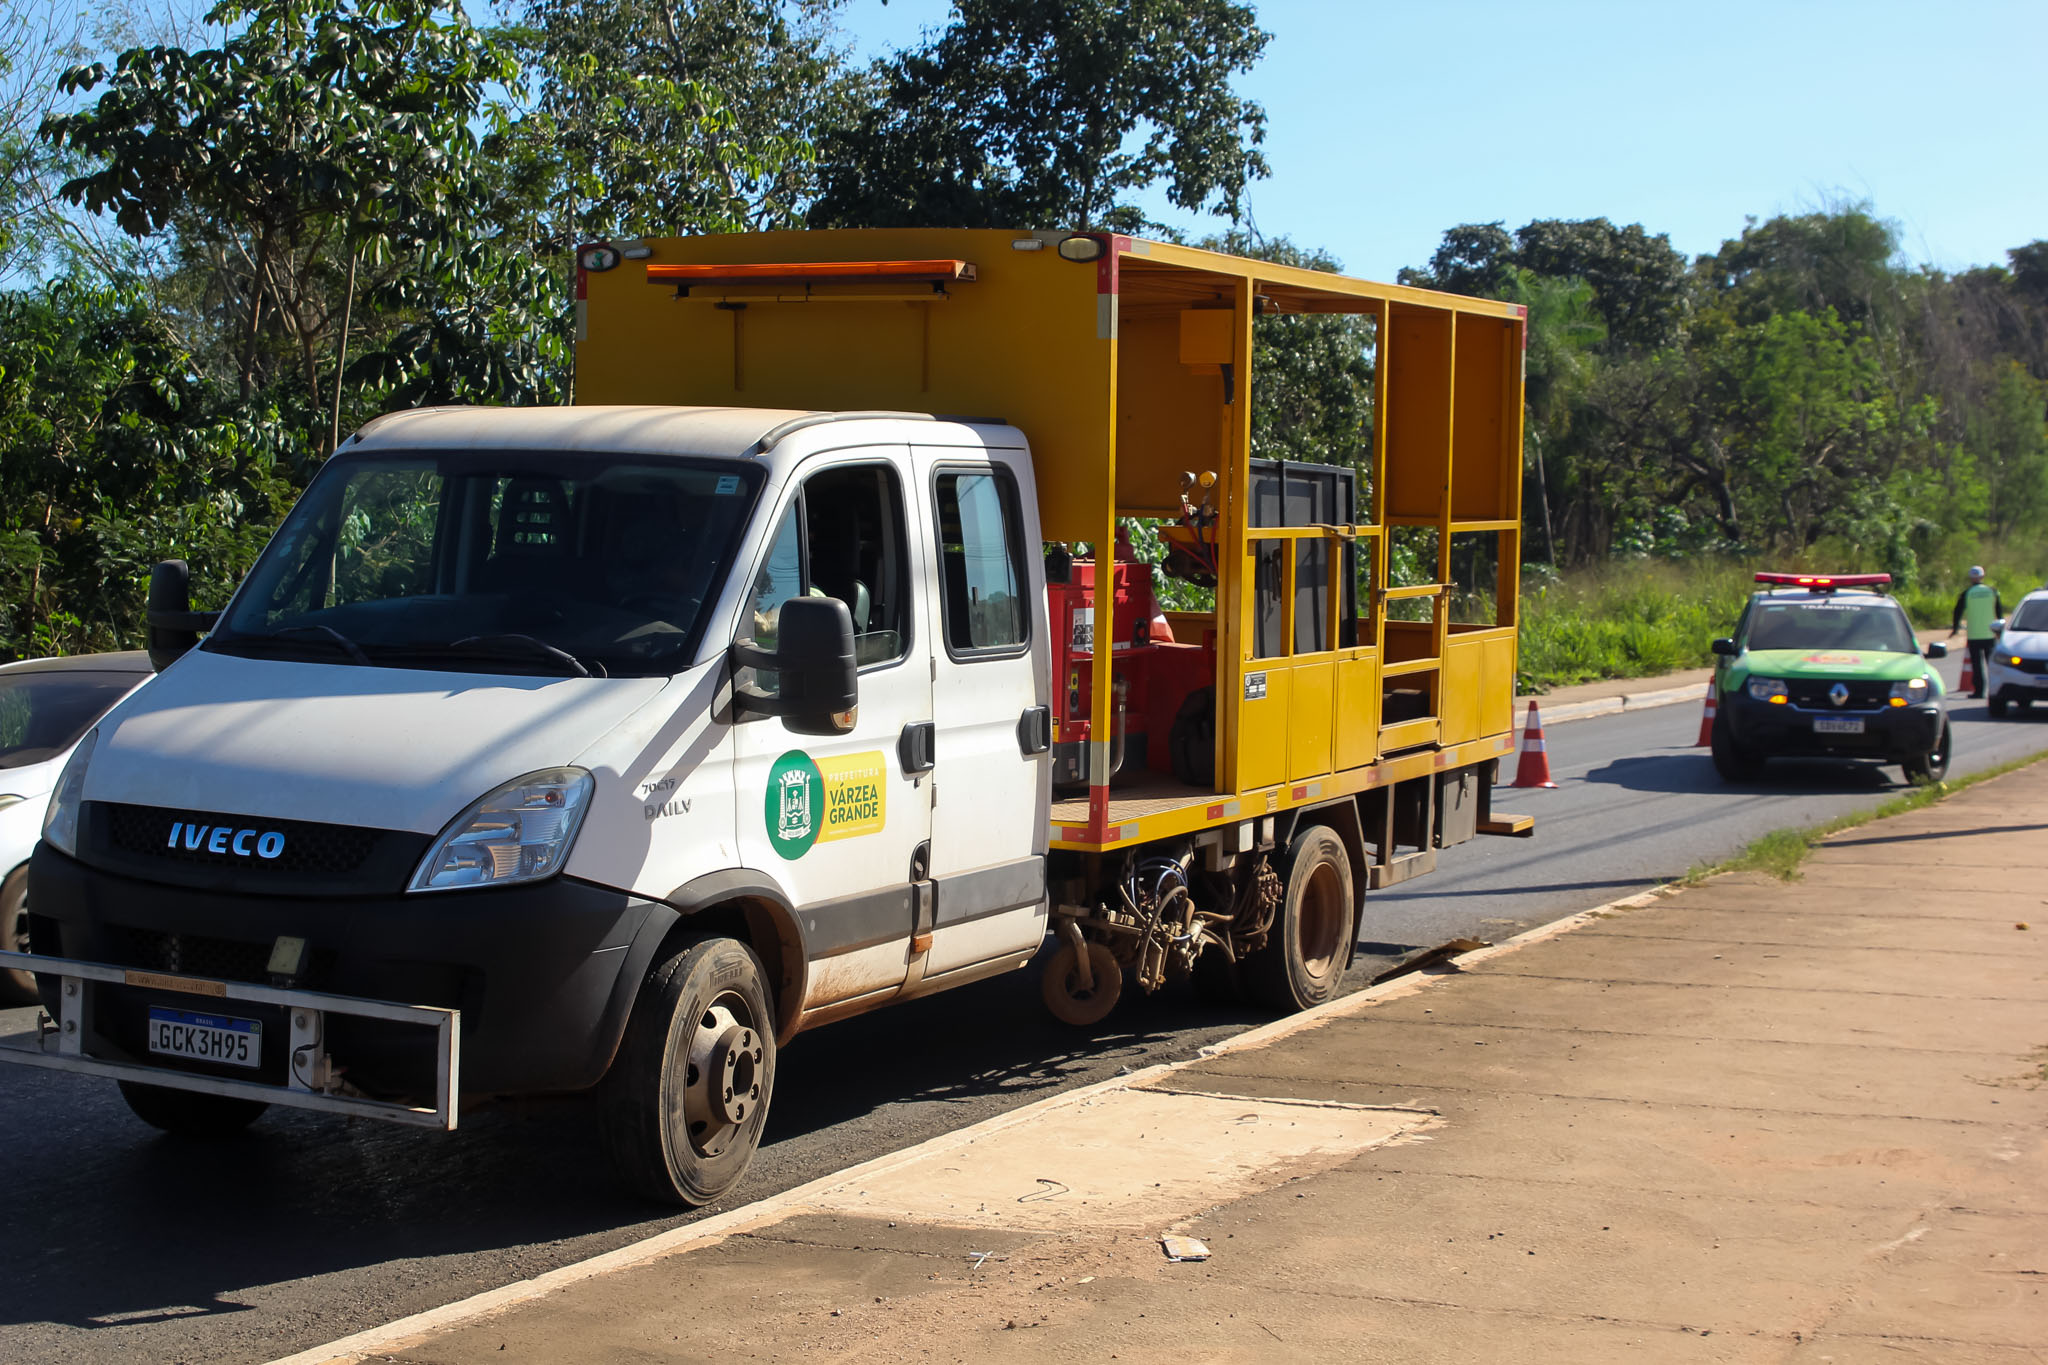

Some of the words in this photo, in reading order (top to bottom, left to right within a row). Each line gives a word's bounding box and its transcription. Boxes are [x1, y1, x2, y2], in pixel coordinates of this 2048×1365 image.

[828, 767, 880, 782] PREFEITURA
[829, 782, 879, 807] VÁRZEA
[644, 797, 693, 820] DAILY
[829, 801, 879, 825] GRANDE
[167, 822, 286, 859] IVECO
[195, 1017, 214, 1026] BRASIL
[160, 1023, 249, 1061] GCK3H95
